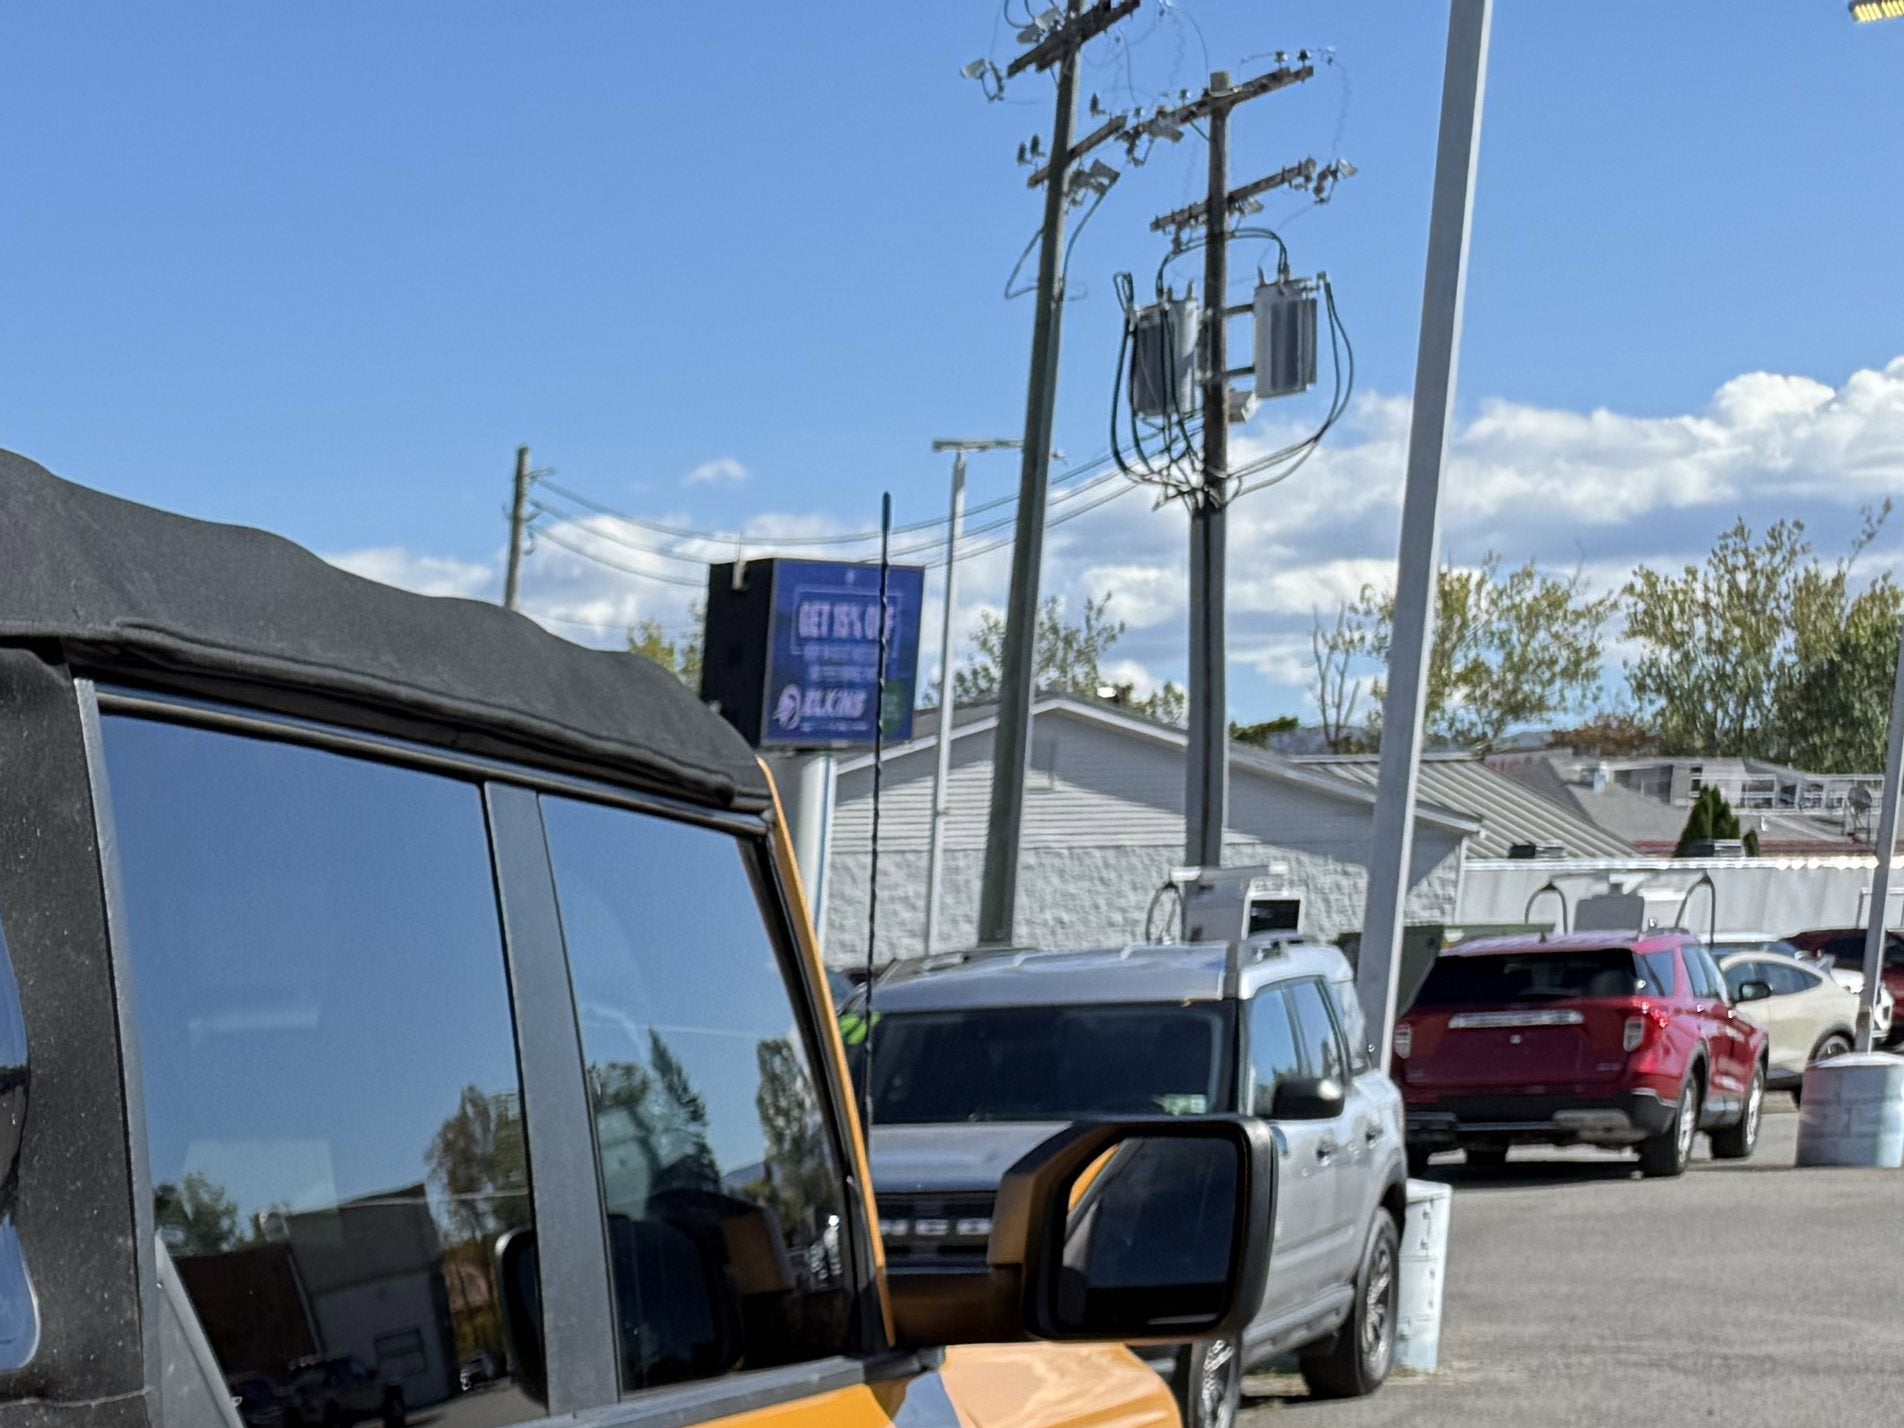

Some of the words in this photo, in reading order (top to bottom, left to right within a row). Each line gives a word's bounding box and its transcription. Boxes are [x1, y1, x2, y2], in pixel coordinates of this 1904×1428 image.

[799, 602, 831, 638] GET
[864, 605, 895, 640] OF
[801, 688, 867, 718] ELKINS
